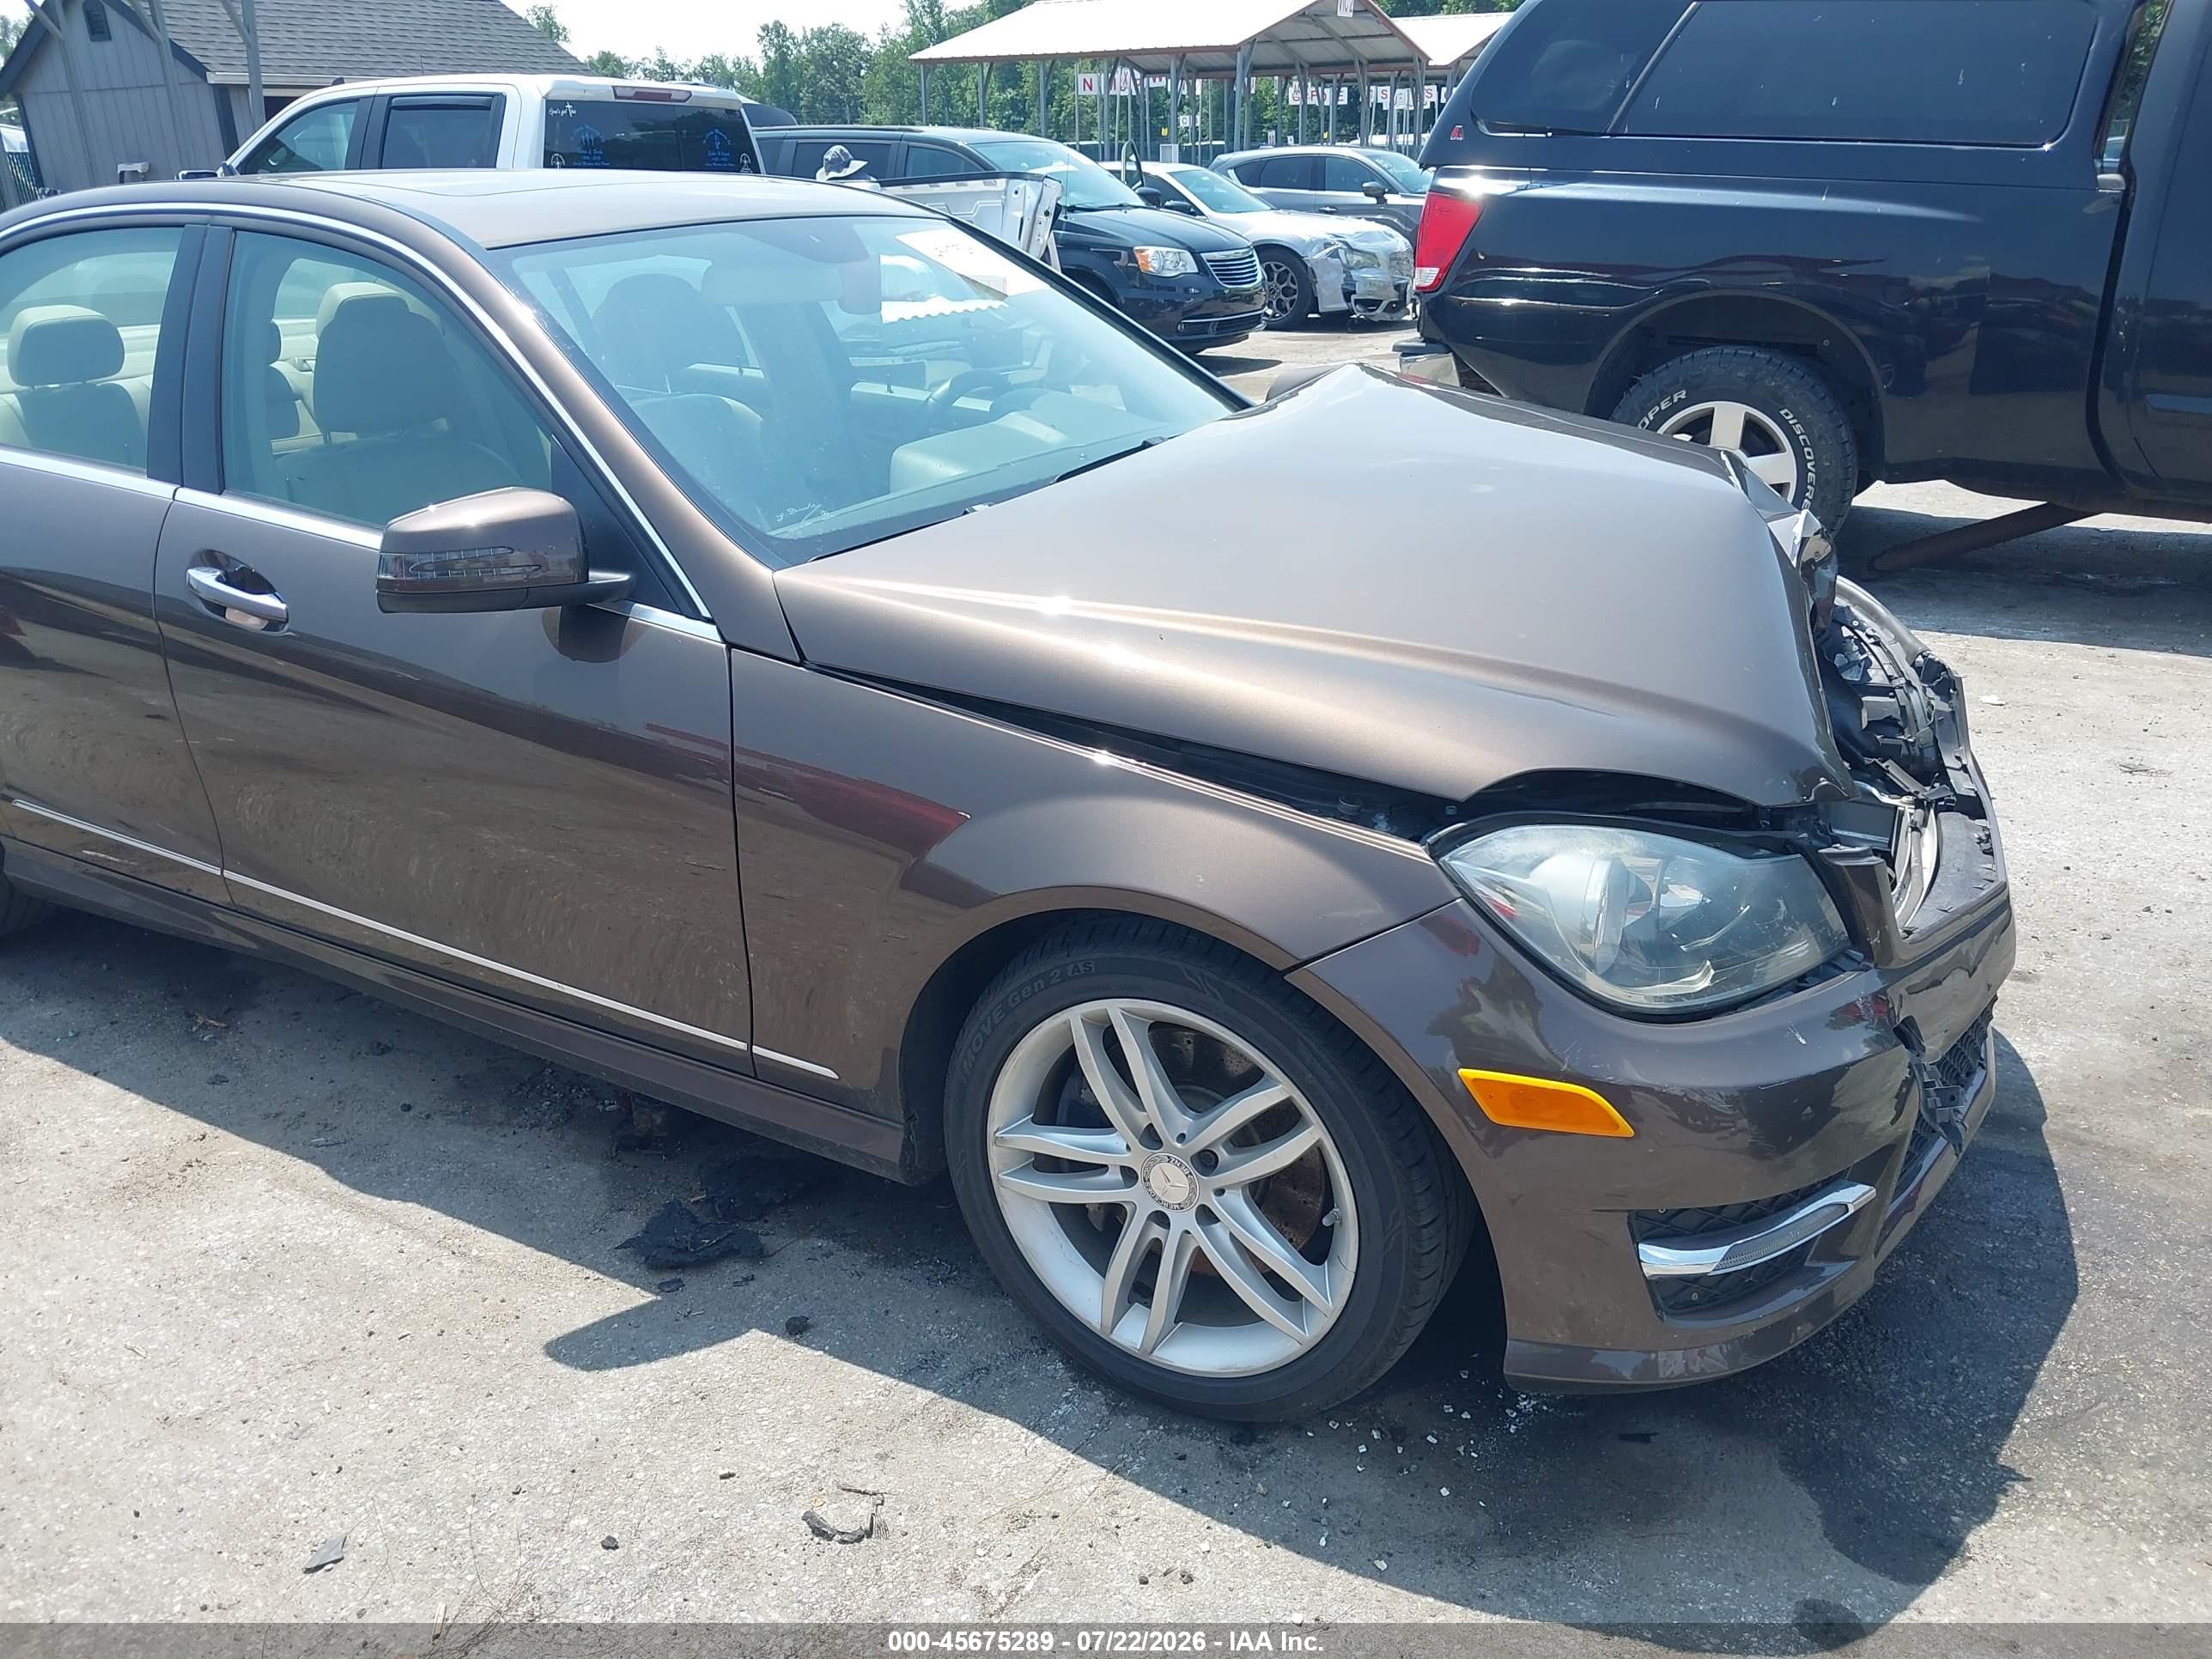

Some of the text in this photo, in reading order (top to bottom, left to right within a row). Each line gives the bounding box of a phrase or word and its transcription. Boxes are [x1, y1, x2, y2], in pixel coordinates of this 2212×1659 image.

[1083, 77, 1093, 92] N
[1007, 978, 1046, 1008] Gen
[1050, 969, 1062, 983] 2
[1070, 960, 1094, 976] AS
[1168, 1156, 1191, 1176] BENZ
[1143, 1181, 1181, 1210] MERCEDES
